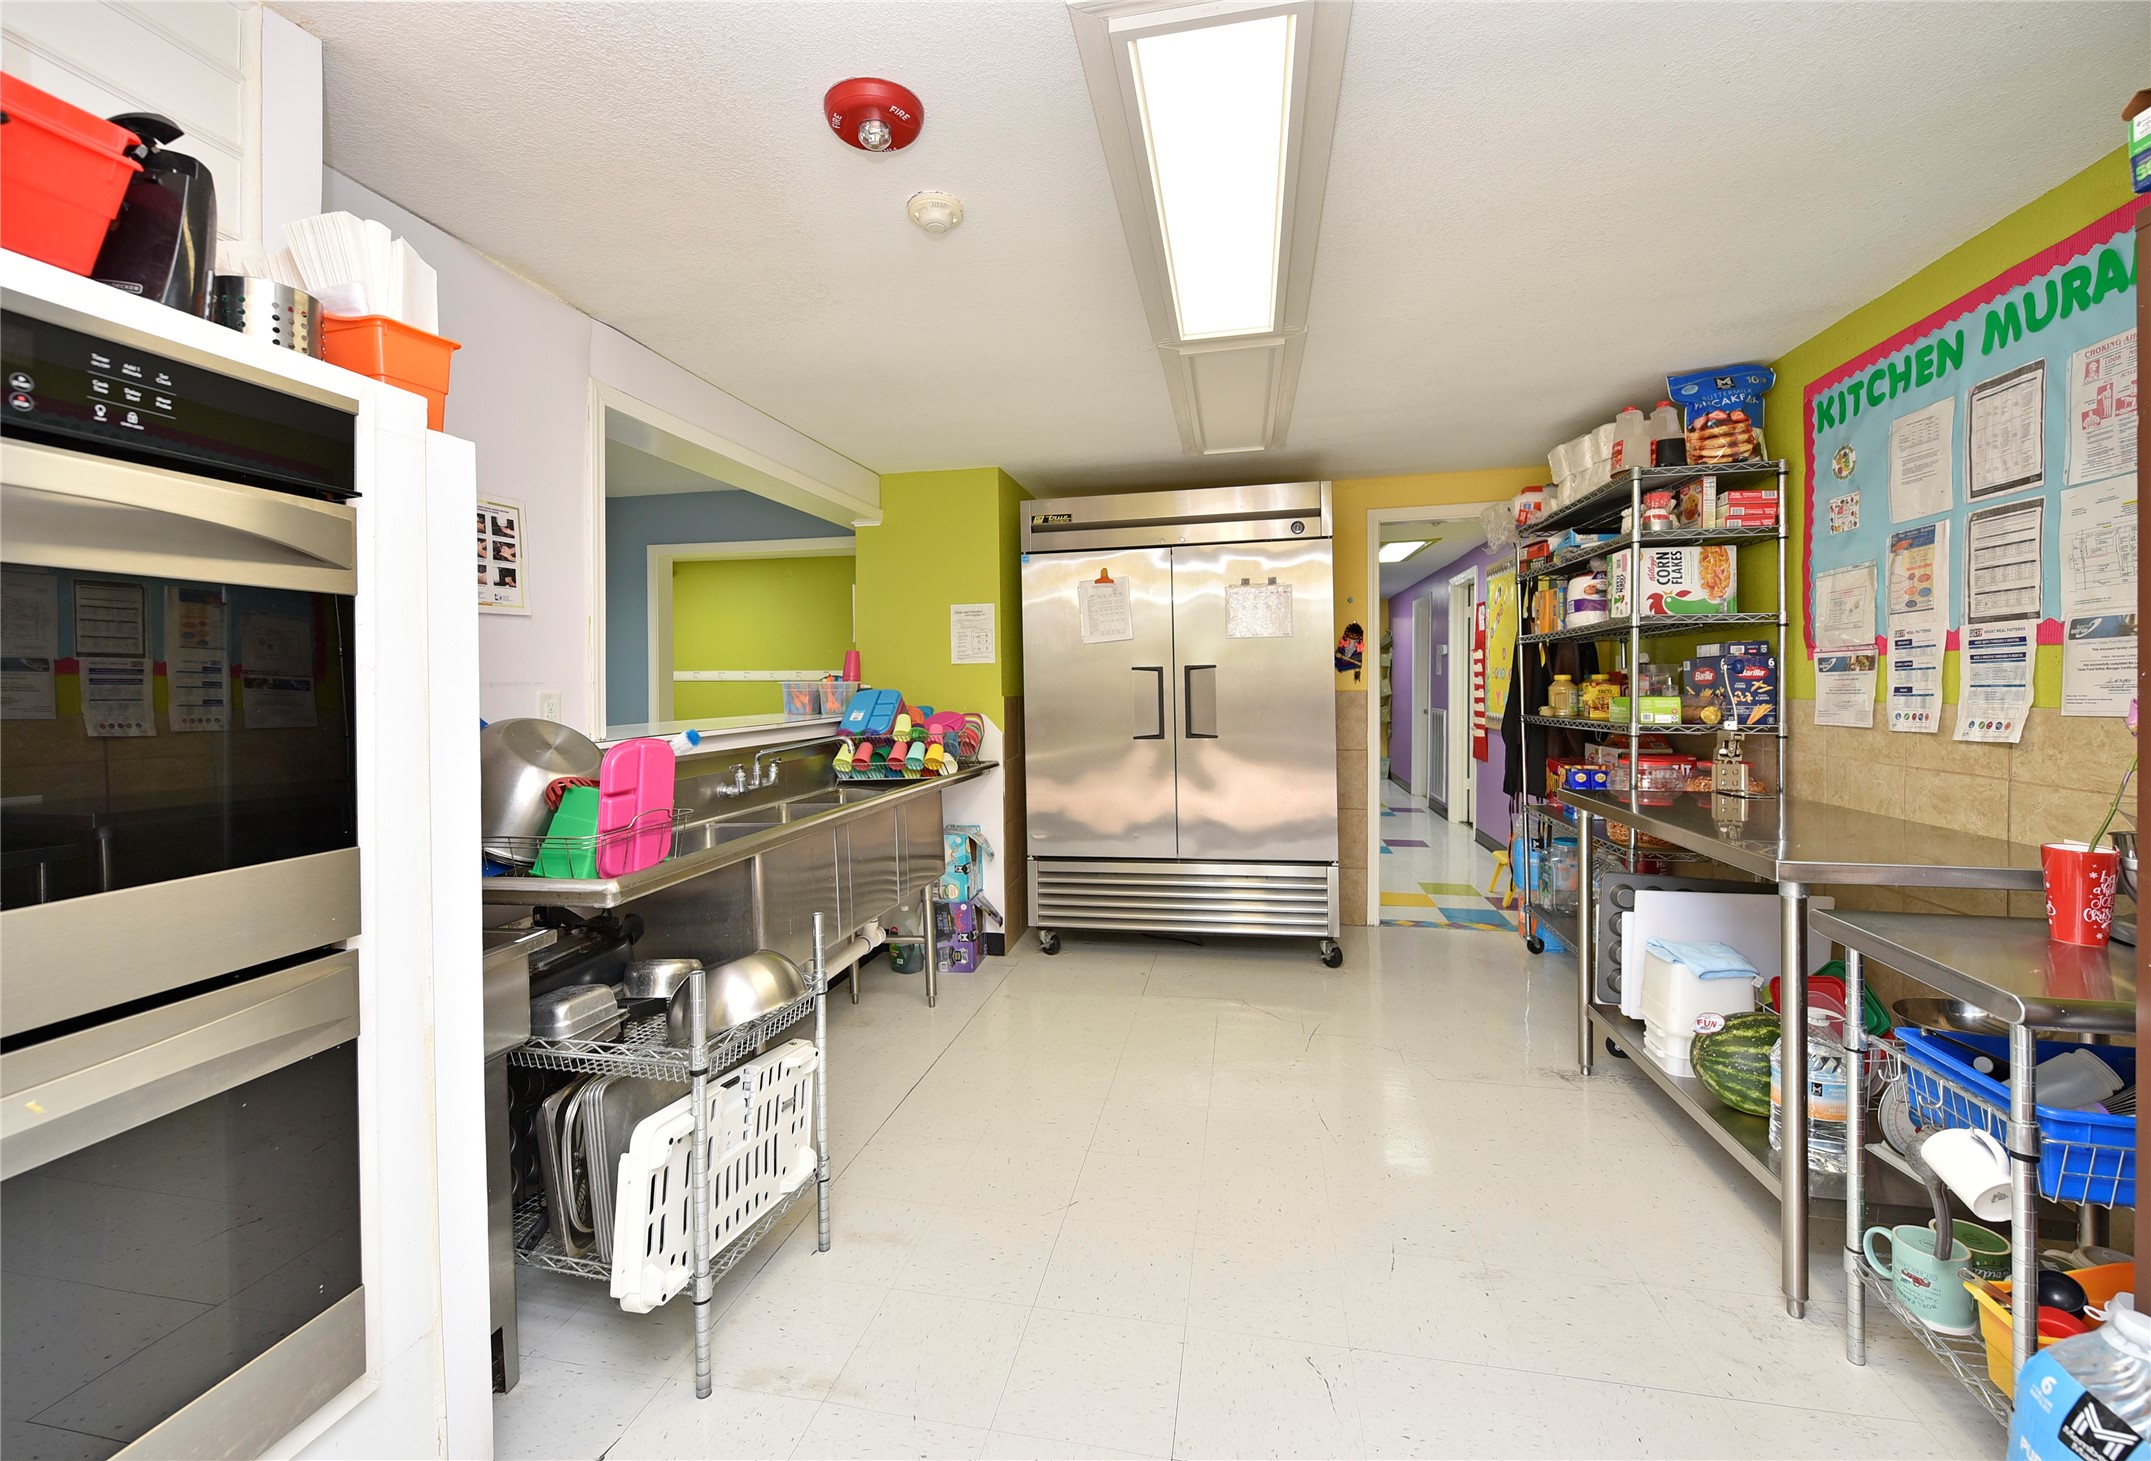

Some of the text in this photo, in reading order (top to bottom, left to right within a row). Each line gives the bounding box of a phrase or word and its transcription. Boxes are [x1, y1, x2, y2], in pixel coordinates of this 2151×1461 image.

[831, 112, 843, 129] FIRE
[888, 105, 911, 121] FIRE
[2084, 338, 2122, 358] CHOKING
[1746, 375, 1759, 384] 10
[1816, 329, 1964, 434] KITCHEN
[1701, 388, 1753, 401] BUTTERMILK
[1656, 551, 1670, 585] CORN
[1670, 550, 1683, 585] FLAKES
[1768, 657, 1775, 667] 6
[1694, 670, 1714, 681] Barilla
[1738, 669, 1767, 677] arilla
[1696, 1019, 1717, 1028] FUN
[2040, 1376, 2058, 1396] 6
